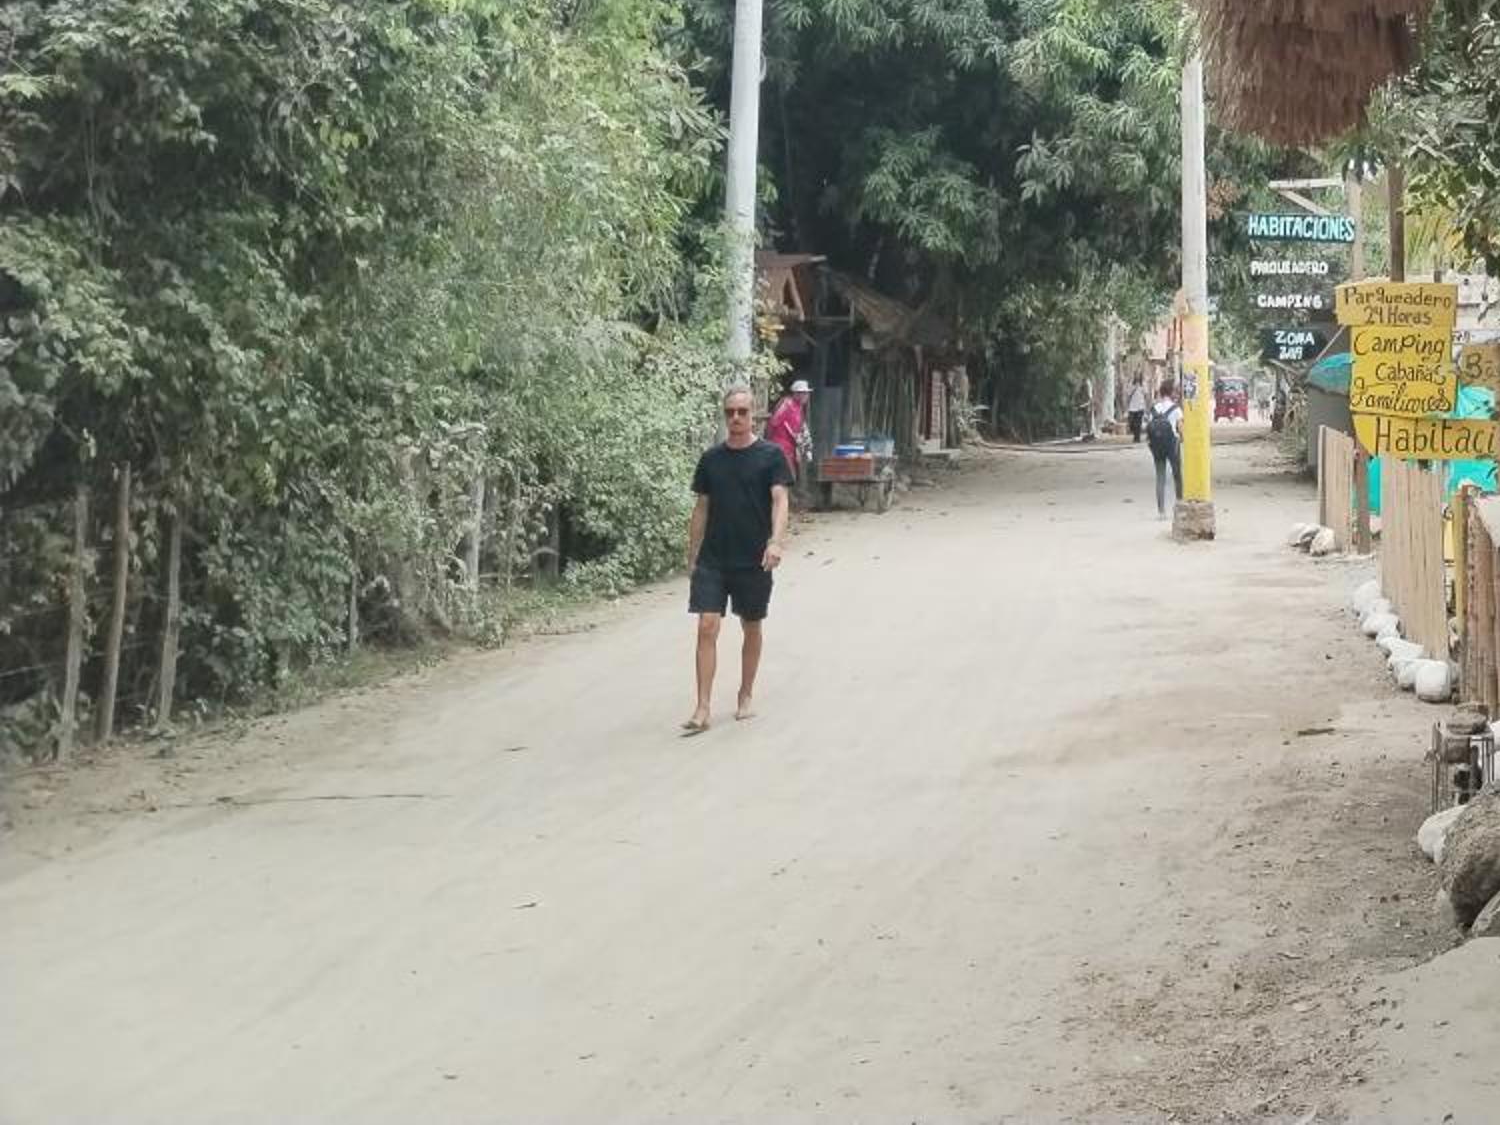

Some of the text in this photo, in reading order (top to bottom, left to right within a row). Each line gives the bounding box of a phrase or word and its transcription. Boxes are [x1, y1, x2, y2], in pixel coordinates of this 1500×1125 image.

[1248, 214, 1355, 242] HABITACIONES
[1257, 294, 1323, 310] CAMPING
[1343, 286, 1452, 309] Parqueadero
[1363, 305, 1434, 325] 24 Horas
[1273, 330, 1316, 346] ZONA
[1353, 330, 1446, 364] Camping
[1375, 361, 1447, 386] Cabañas
